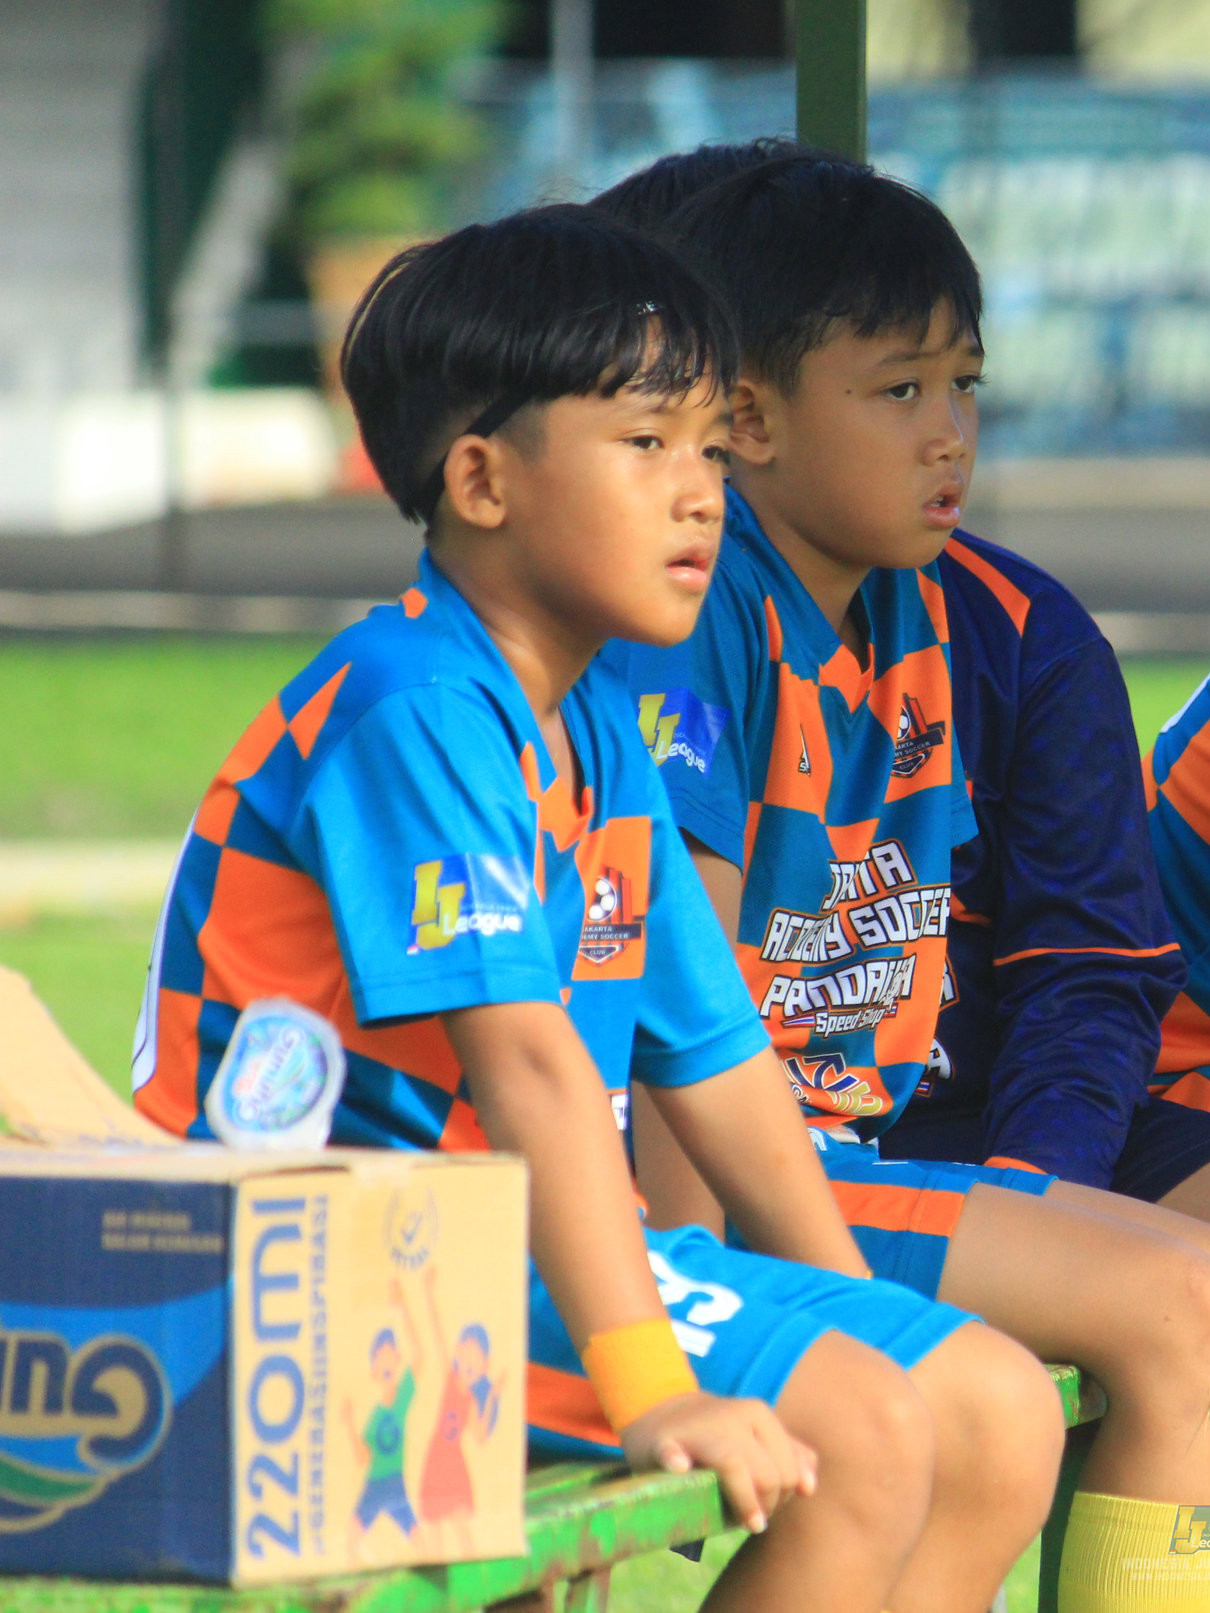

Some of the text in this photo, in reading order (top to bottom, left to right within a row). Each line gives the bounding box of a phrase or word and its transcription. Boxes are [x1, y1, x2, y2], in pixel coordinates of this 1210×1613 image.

[656, 741, 706, 773] League
[443, 911, 523, 938] League
[600, 932, 628, 940] SOCCER
[816, 1009, 861, 1037] Speed
[246, 1195, 306, 1559] 220ml
